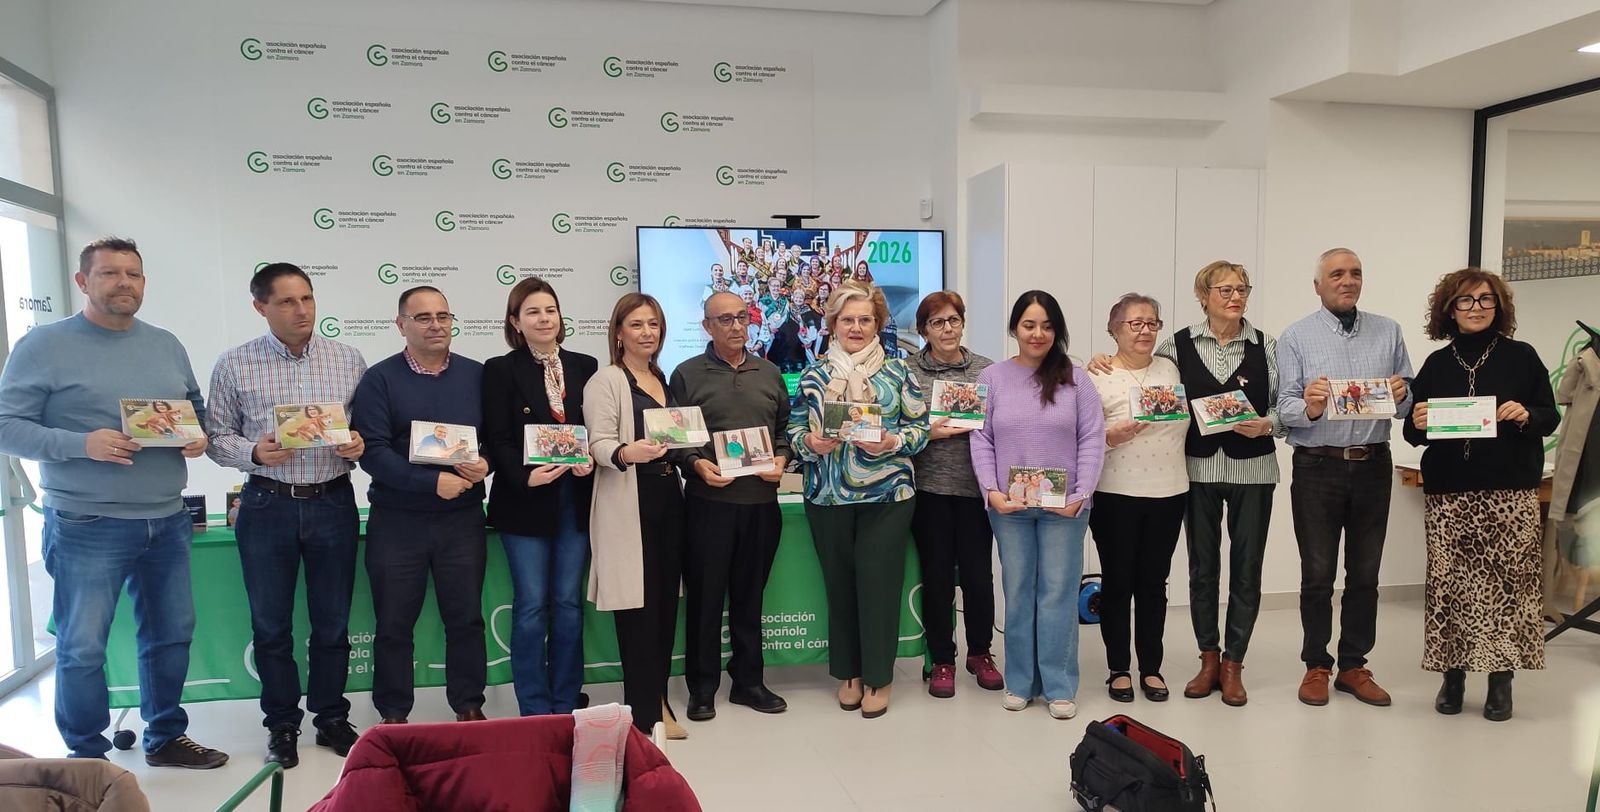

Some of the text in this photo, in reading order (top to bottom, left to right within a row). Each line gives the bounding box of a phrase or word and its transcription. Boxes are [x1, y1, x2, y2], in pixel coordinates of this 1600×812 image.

[868, 240, 912, 264] 2026
[760, 611, 816, 624] sociación
[761, 625, 806, 639] spañola
[762, 638, 828, 650] ontra el cán
[355, 662, 368, 674] el
